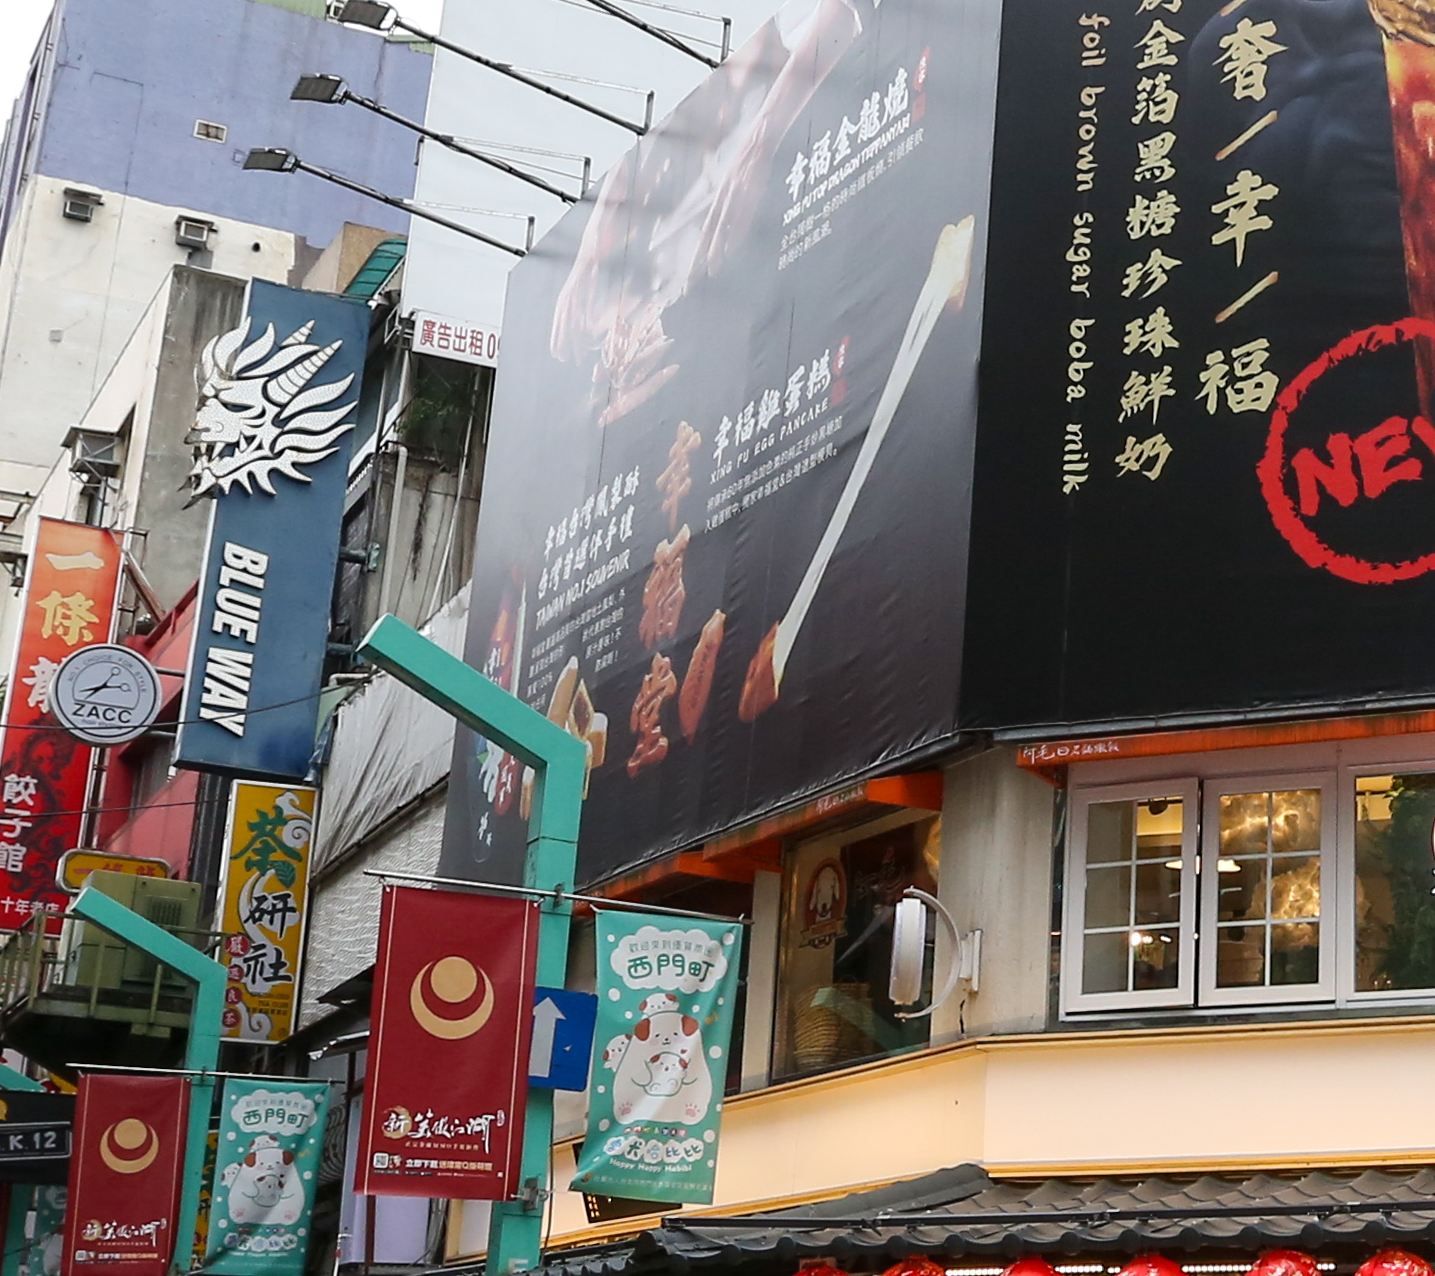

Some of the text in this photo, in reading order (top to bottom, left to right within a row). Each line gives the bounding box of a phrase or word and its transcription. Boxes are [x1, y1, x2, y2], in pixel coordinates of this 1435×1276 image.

[1081, 13, 1111, 68] foil
[1074, 86, 1106, 193] brown
[1066, 212, 1093, 299] sugar
[418, 319, 485, 357] 廣告出租
[1066, 318, 1096, 403] boba
[1063, 423, 1087, 496] milk
[199, 542, 269, 737] BLUE WAY
[72, 702, 133, 723] ZACC
[230, 803, 303, 986] 茶研社
[627, 953, 715, 983] 西門町
[243, 1108, 309, 1129] 西門町
